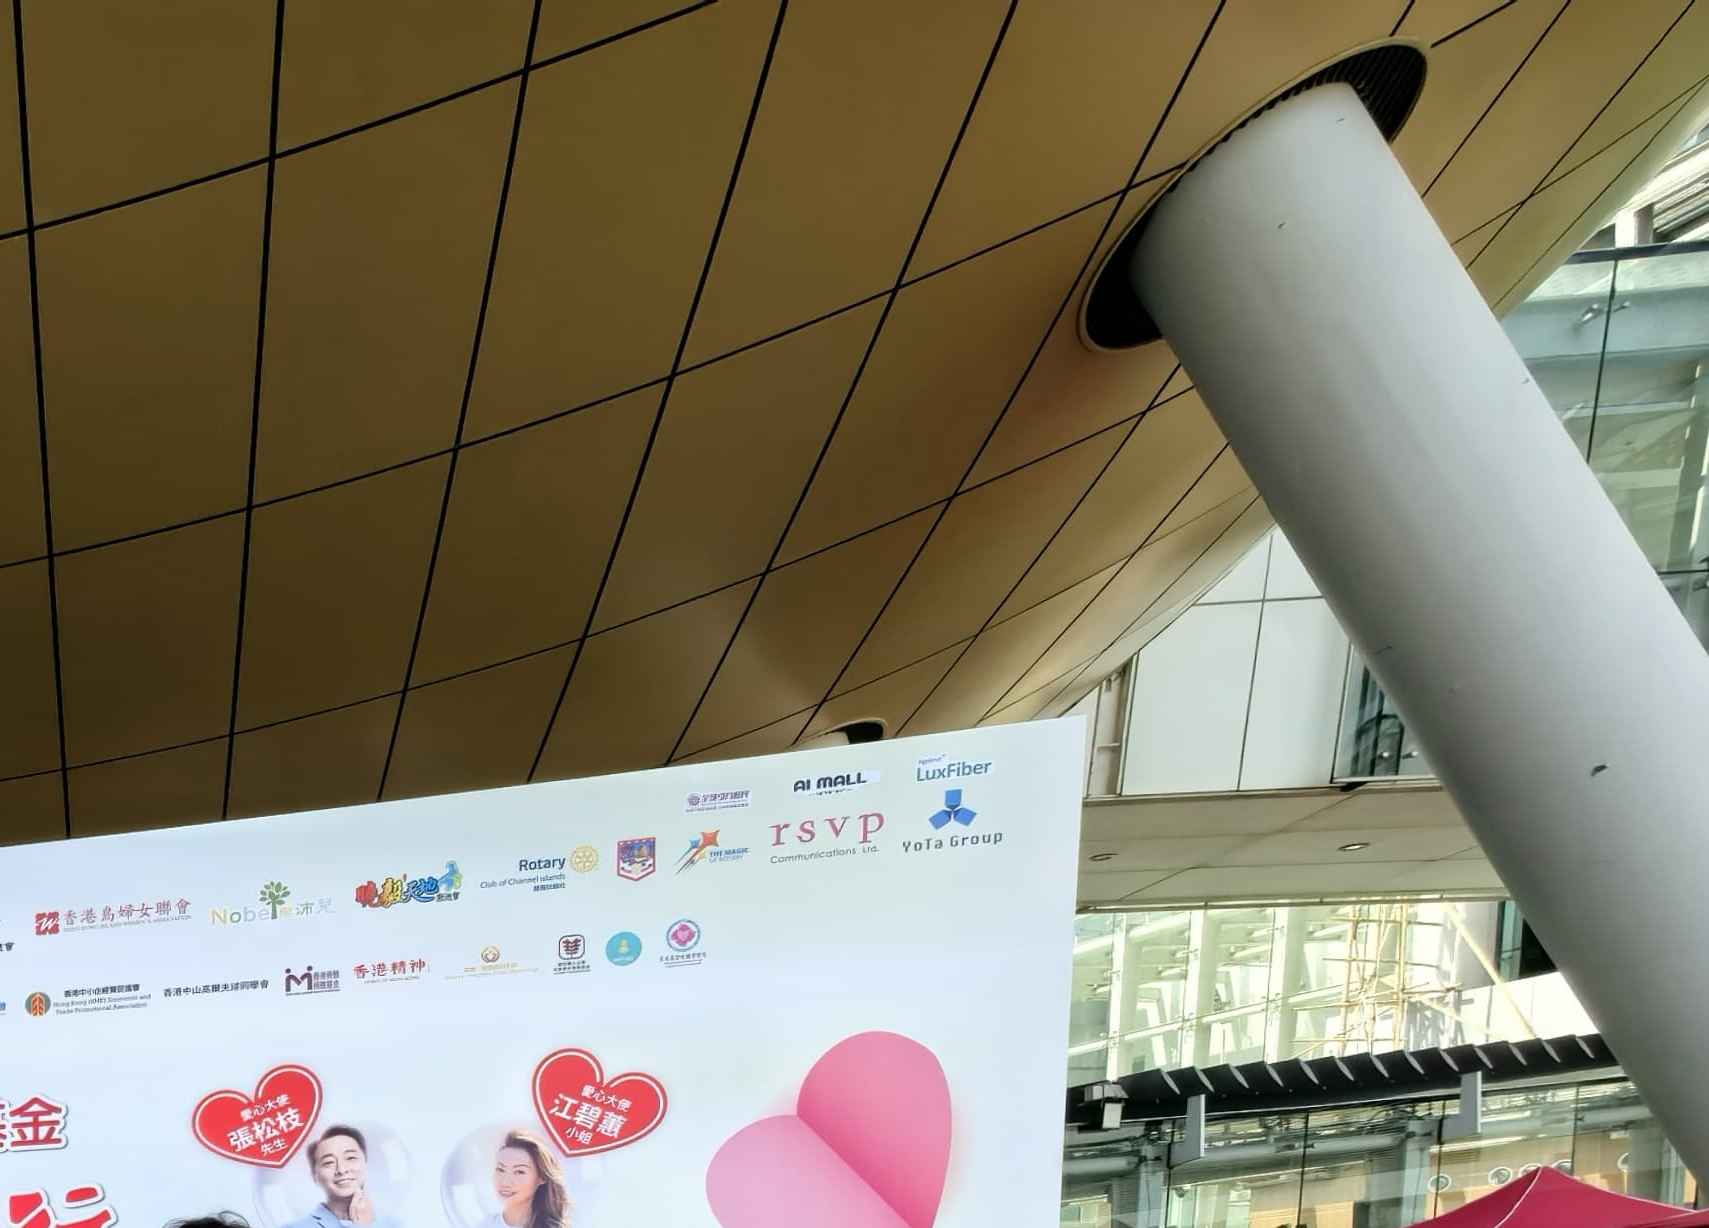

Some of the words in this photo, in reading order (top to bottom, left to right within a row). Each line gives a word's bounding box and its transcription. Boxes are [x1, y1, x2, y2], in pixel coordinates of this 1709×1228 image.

[916, 760, 992, 782] LuxFiber
[793, 779, 811, 793] AI
[949, 831, 1004, 848] Group
[518, 857, 566, 872] Rotary
[769, 846, 857, 864] Communications
[63, 897, 192, 926] 香港島婦女聯會
[353, 958, 426, 979] 香港精神
[240, 1093, 291, 1123] 愛心大使
[580, 1083, 633, 1113] 愛心大使
[226, 1107, 305, 1153] 張松枝
[564, 1126, 594, 1145] 小姐
[260, 1137, 290, 1157] 先生
